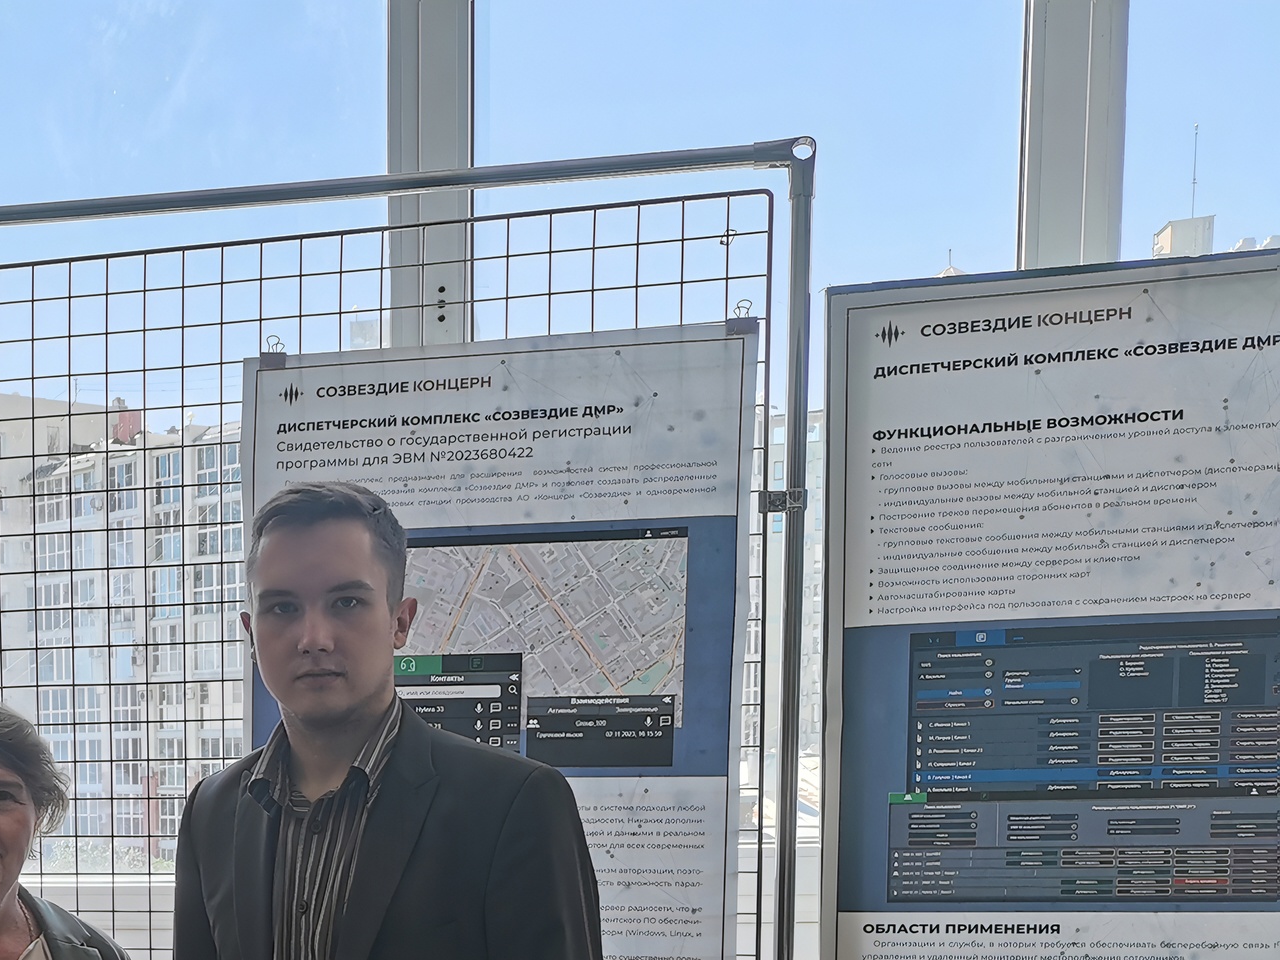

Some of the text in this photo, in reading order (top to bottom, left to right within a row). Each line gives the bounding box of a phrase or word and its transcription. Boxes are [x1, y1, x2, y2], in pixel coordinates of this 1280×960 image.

[920, 307, 1132, 337] СОЗВЕЗДИЕ КОНЦЕРН
[874, 352, 1018, 380] ДИСПЕТЧЕРСКИЙ
[1024, 347, 1119, 366] КОМПЛЕКС
[1124, 338, 1238, 357] «СОЗВЕЗДИЕ
[316, 376, 491, 398] СОЗВЕЗДИЕ КОНЦЕРН
[276, 405, 624, 435] ДИСПЕТЧЕРСКИЙ КОМПЛЕКС «СОЗВЕЗДИЕ ДМР»
[872, 409, 1184, 442] ФУНКЦИОНАЛЬНЫЕ ВОЗМОЖНОСТИ
[276, 425, 632, 453] Свидетельство о государственной регистрации
[276, 446, 533, 472] программы для ЭВМ №2023680422
[863, 924, 1061, 935] ОБЛАСТИ ПРИМЕНЕНИЯ
